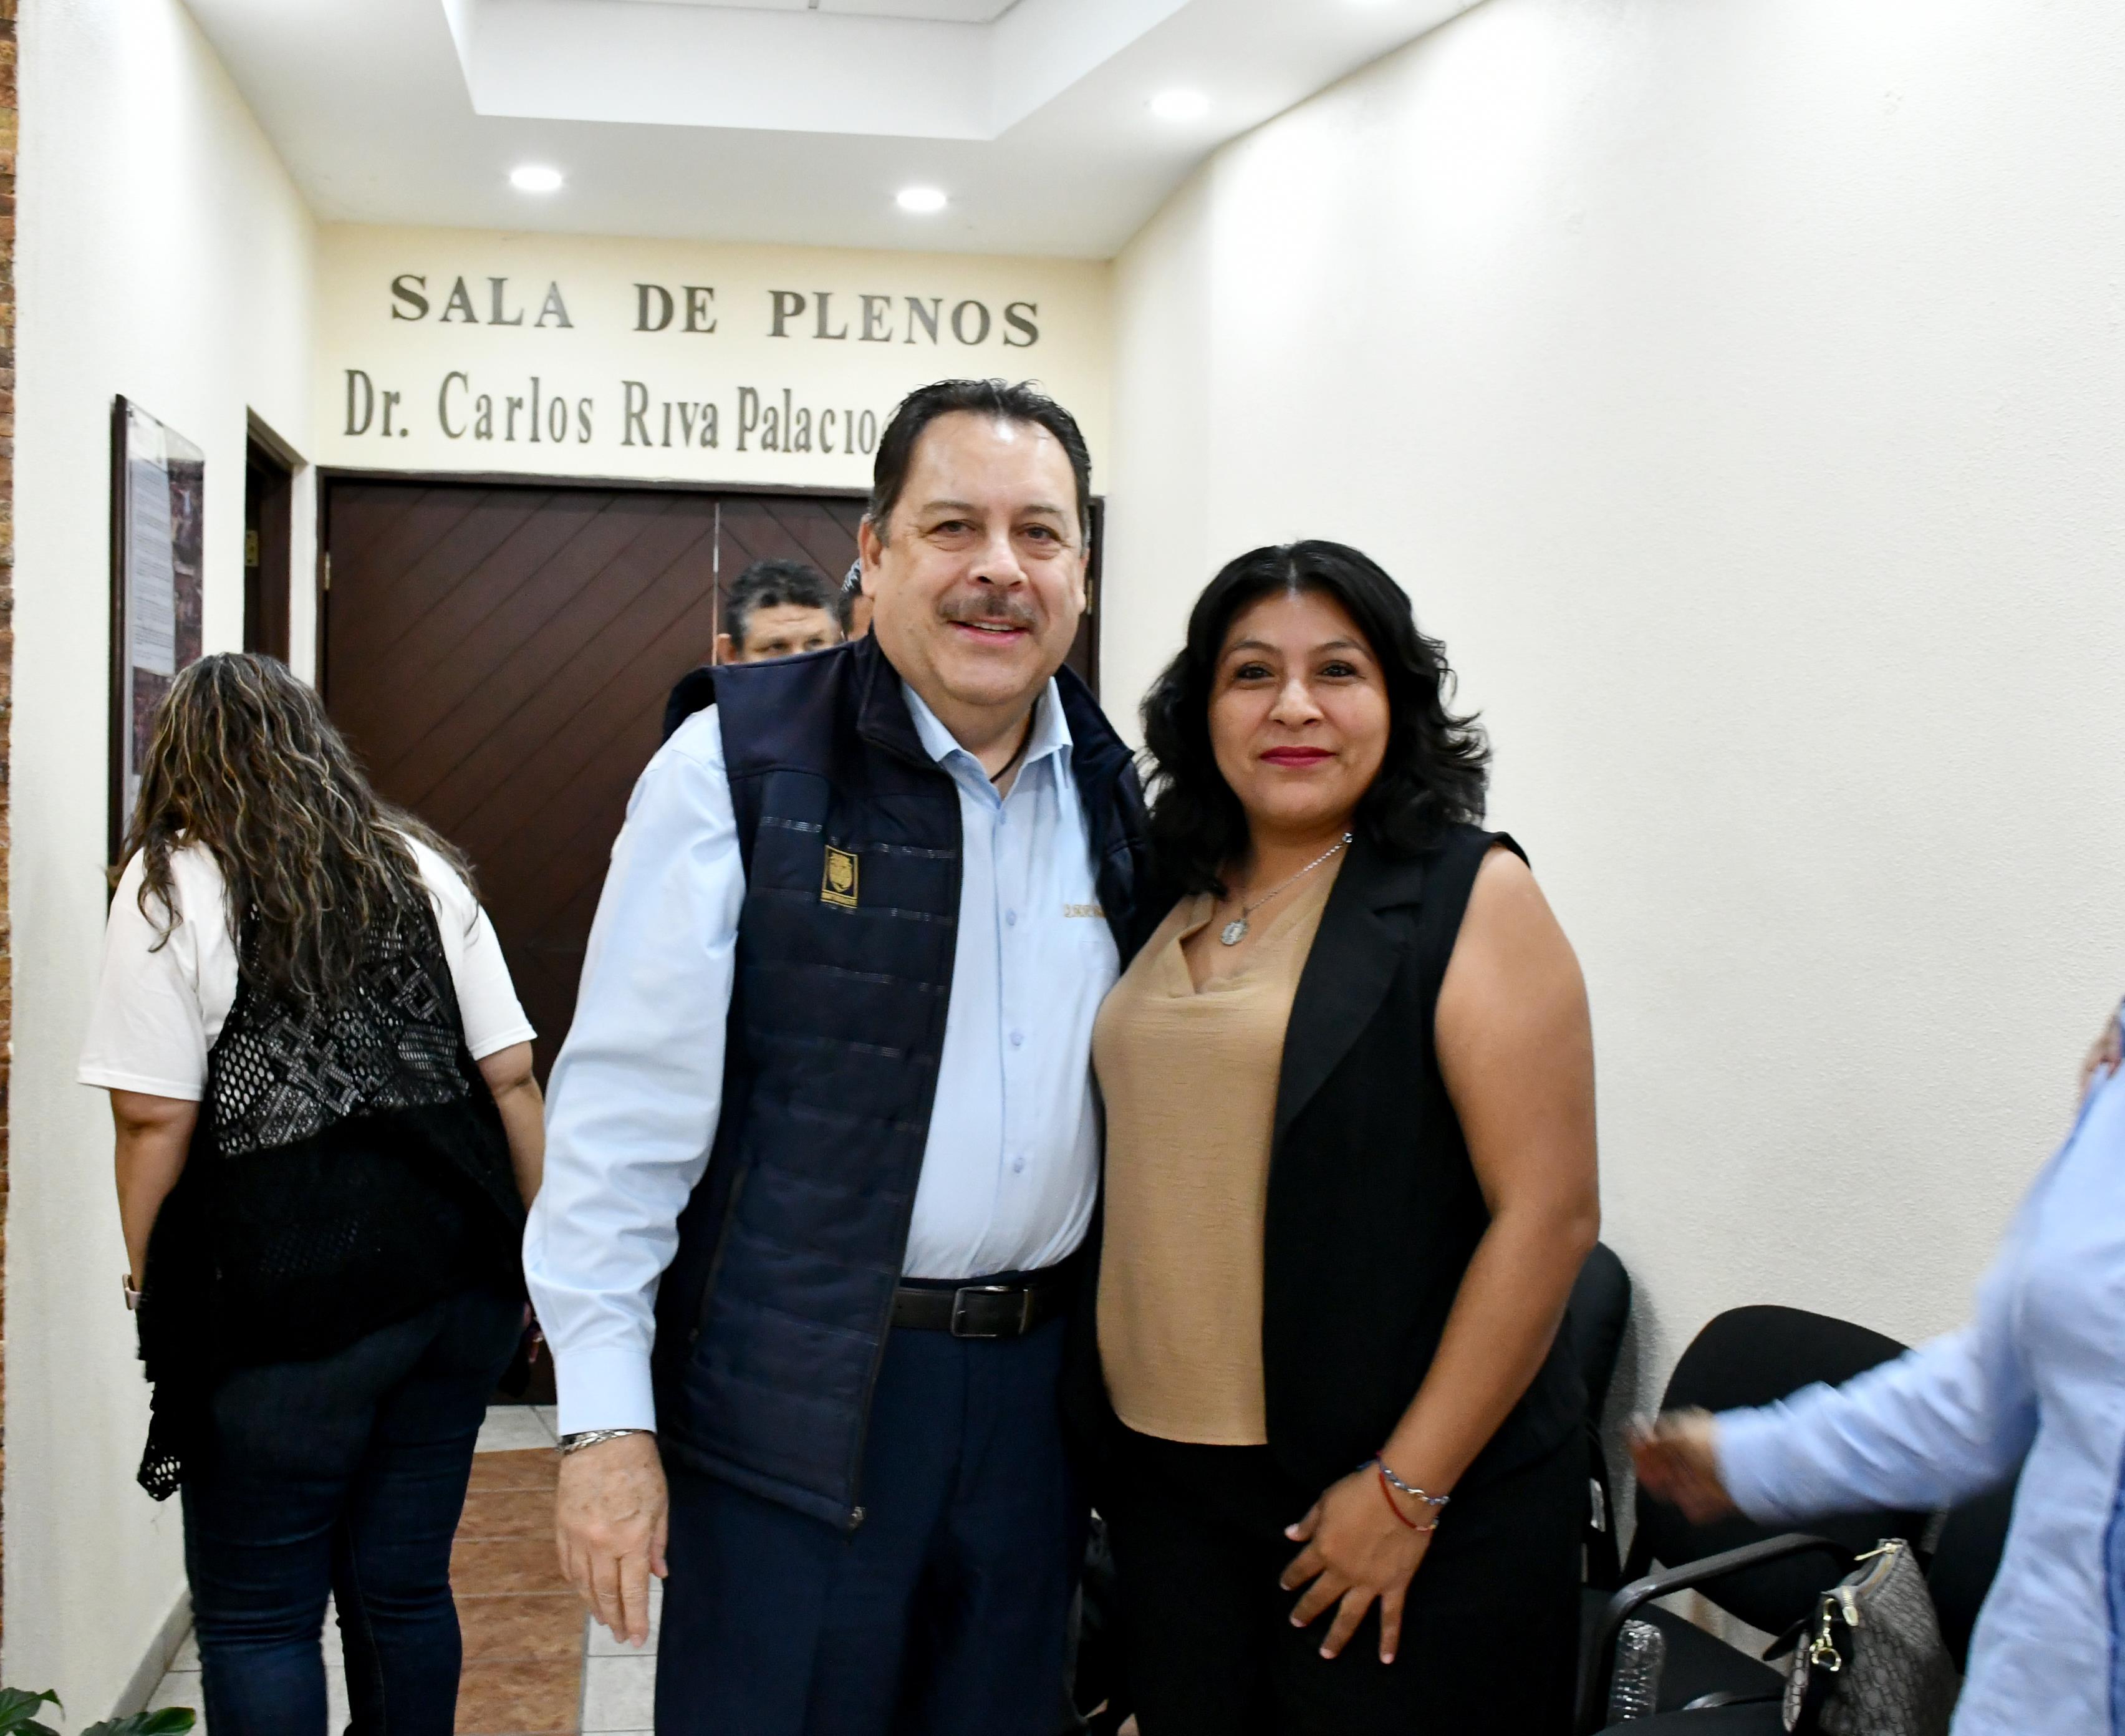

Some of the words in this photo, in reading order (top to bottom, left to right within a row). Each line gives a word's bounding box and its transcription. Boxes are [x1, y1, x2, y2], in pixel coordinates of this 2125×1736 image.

[390, 273, 575, 329] SALA
[632, 282, 718, 335] DE
[766, 289, 1040, 349] PLENOS
[342, 368, 410, 439] Dr.
[437, 370, 594, 445] Carlos
[620, 379, 720, 450] Riva
[735, 385, 877, 456] Palacio
